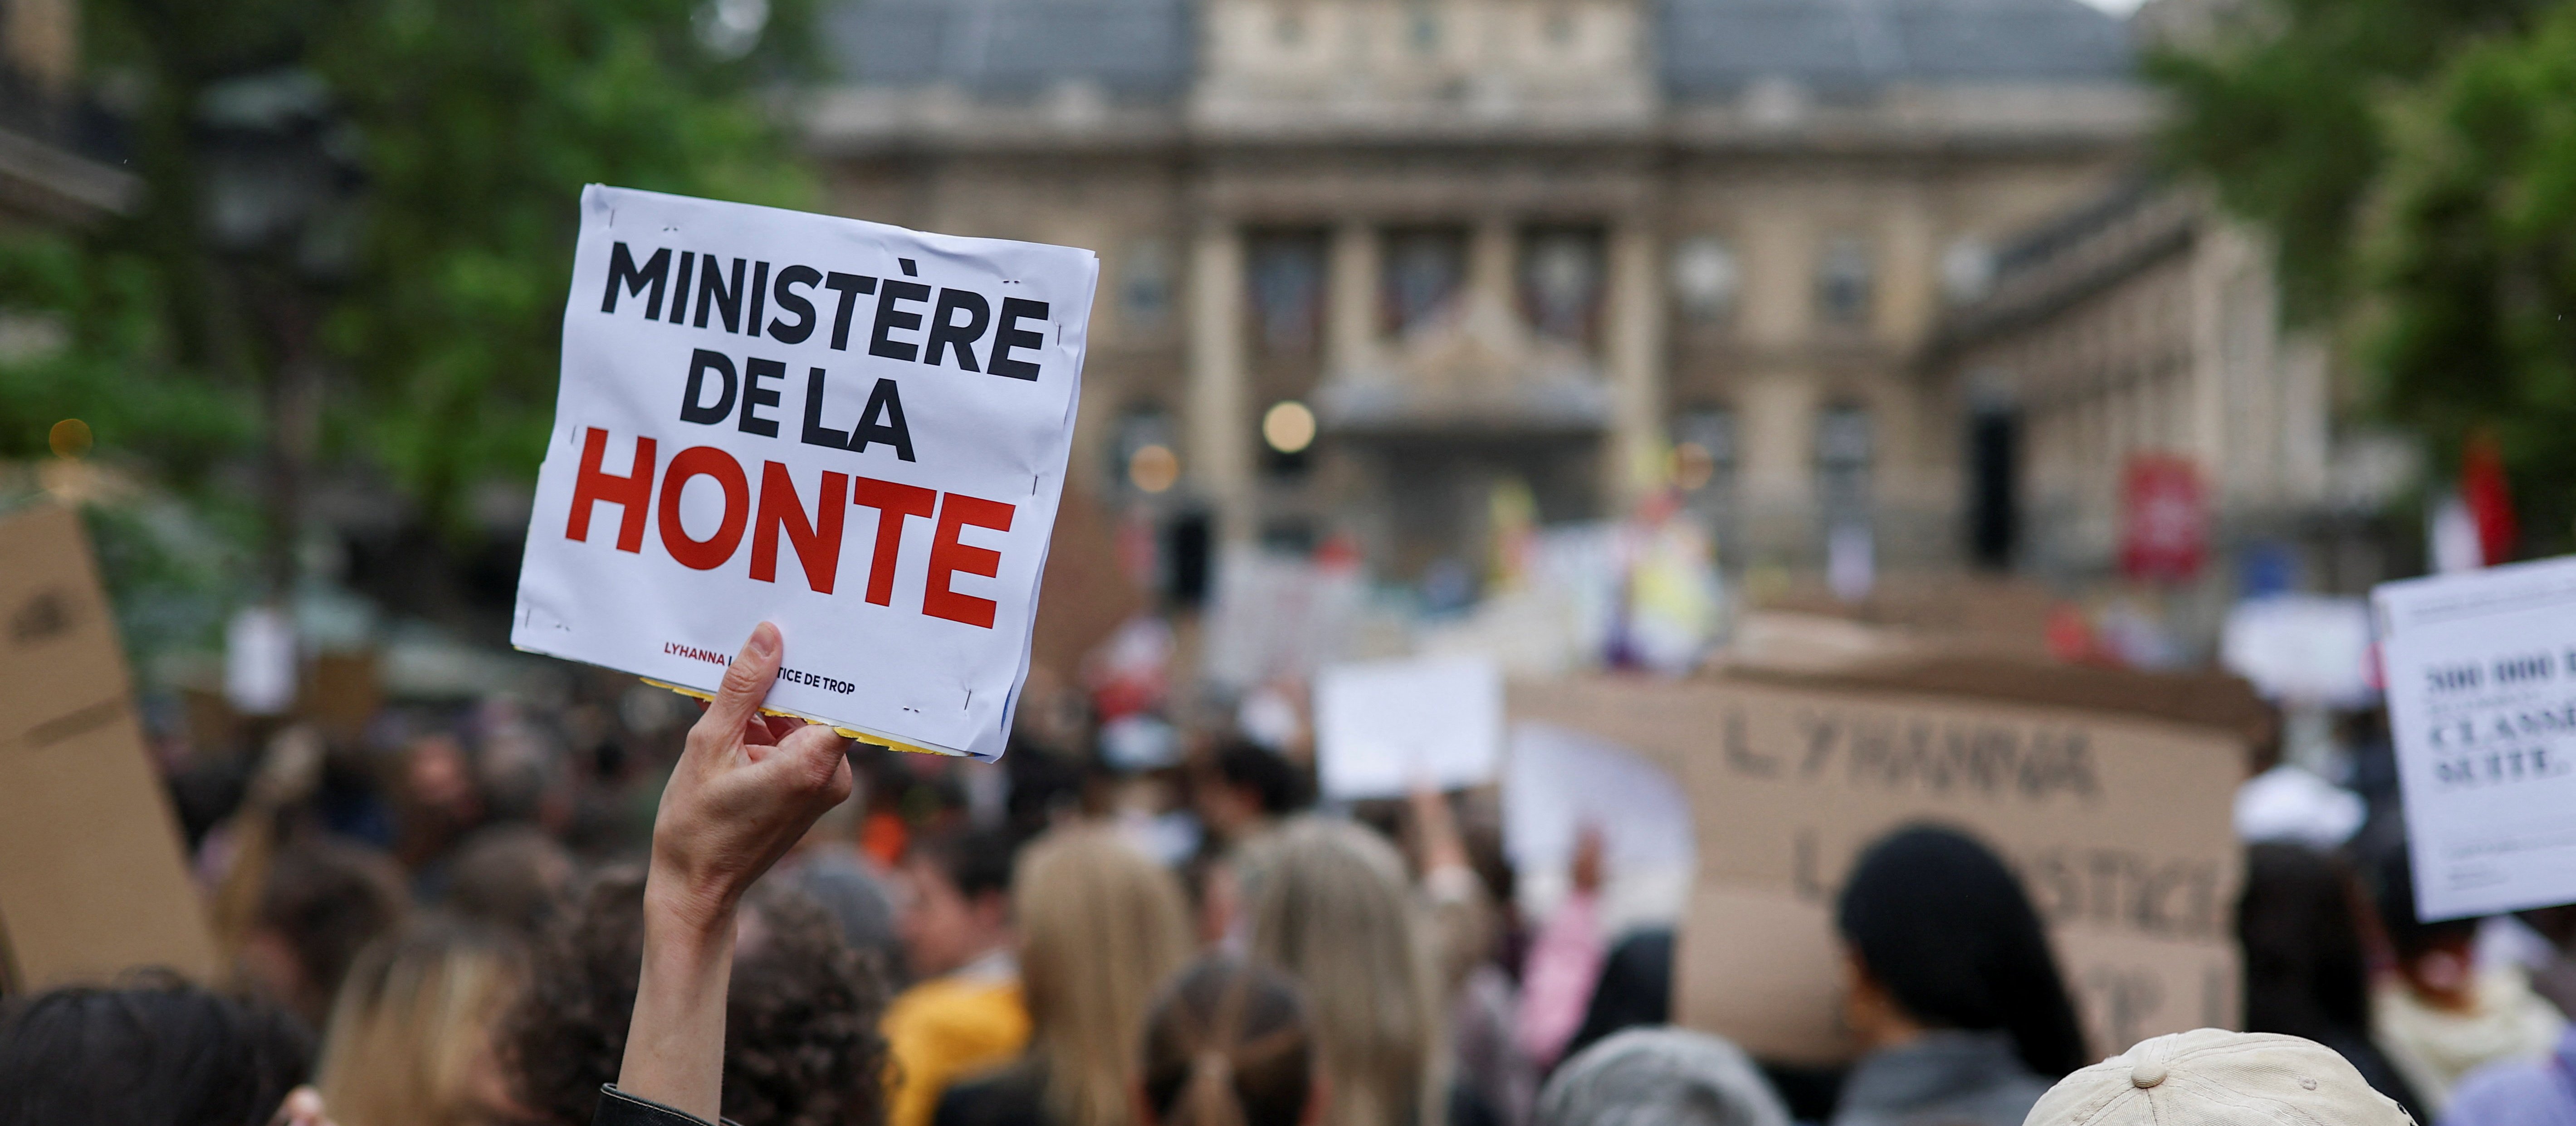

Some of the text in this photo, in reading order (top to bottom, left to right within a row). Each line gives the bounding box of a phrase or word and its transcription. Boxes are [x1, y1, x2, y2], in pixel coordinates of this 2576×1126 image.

[601, 242, 1049, 381] MINISTÈRE
[680, 348, 916, 463] DE LA
[566, 426, 1015, 629] HONTE
[664, 642, 855, 695] LYHANNA DE TROP
[1722, 704, 2104, 803] LYHANNA
